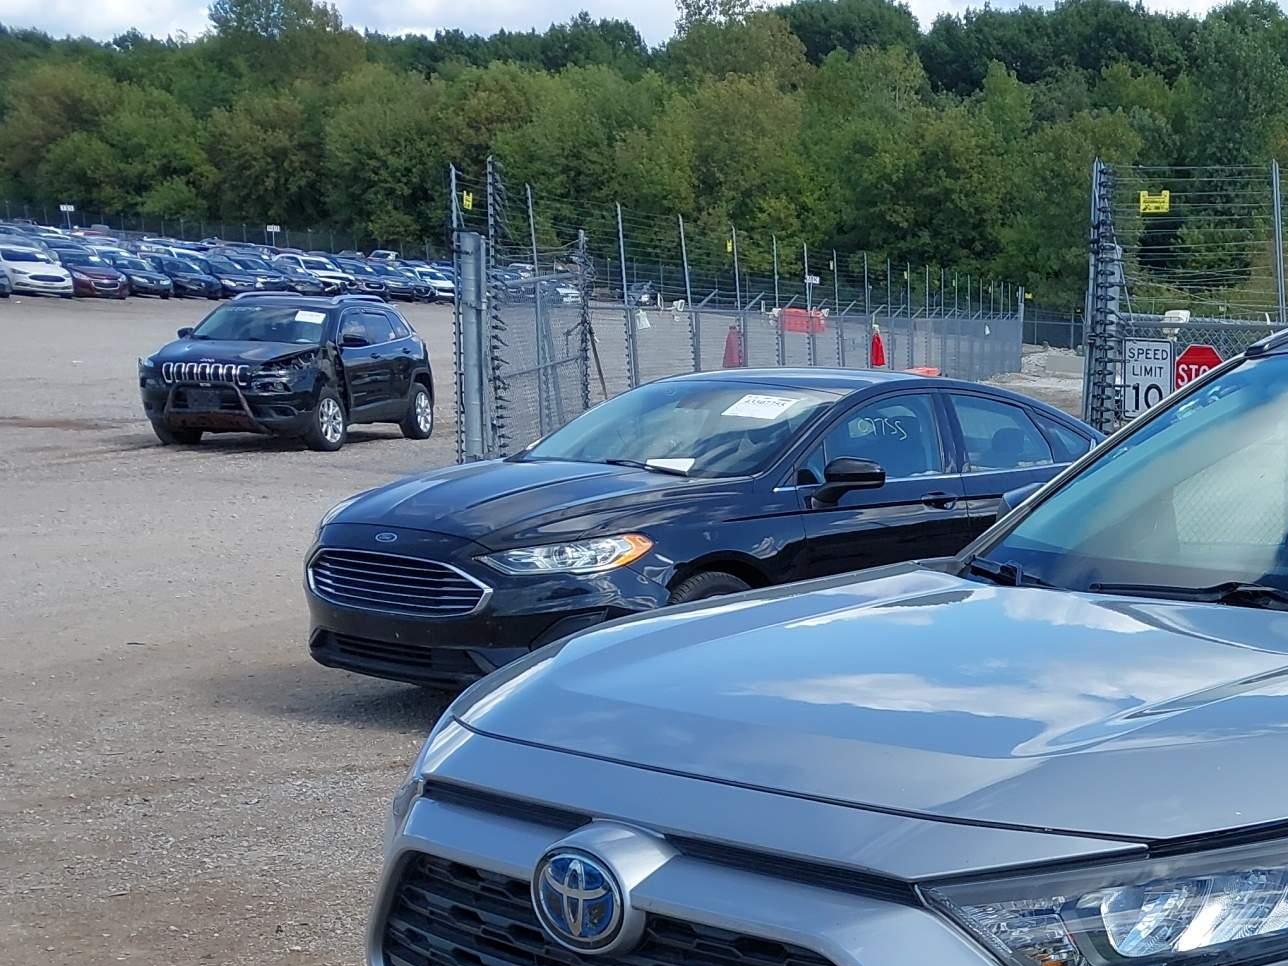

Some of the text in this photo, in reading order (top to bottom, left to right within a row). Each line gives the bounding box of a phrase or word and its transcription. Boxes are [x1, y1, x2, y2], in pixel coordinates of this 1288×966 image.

[1129, 349, 1168, 360] SPEED
[1133, 366, 1163, 377] LIMIT
[1132, 383, 1163, 410] 10
